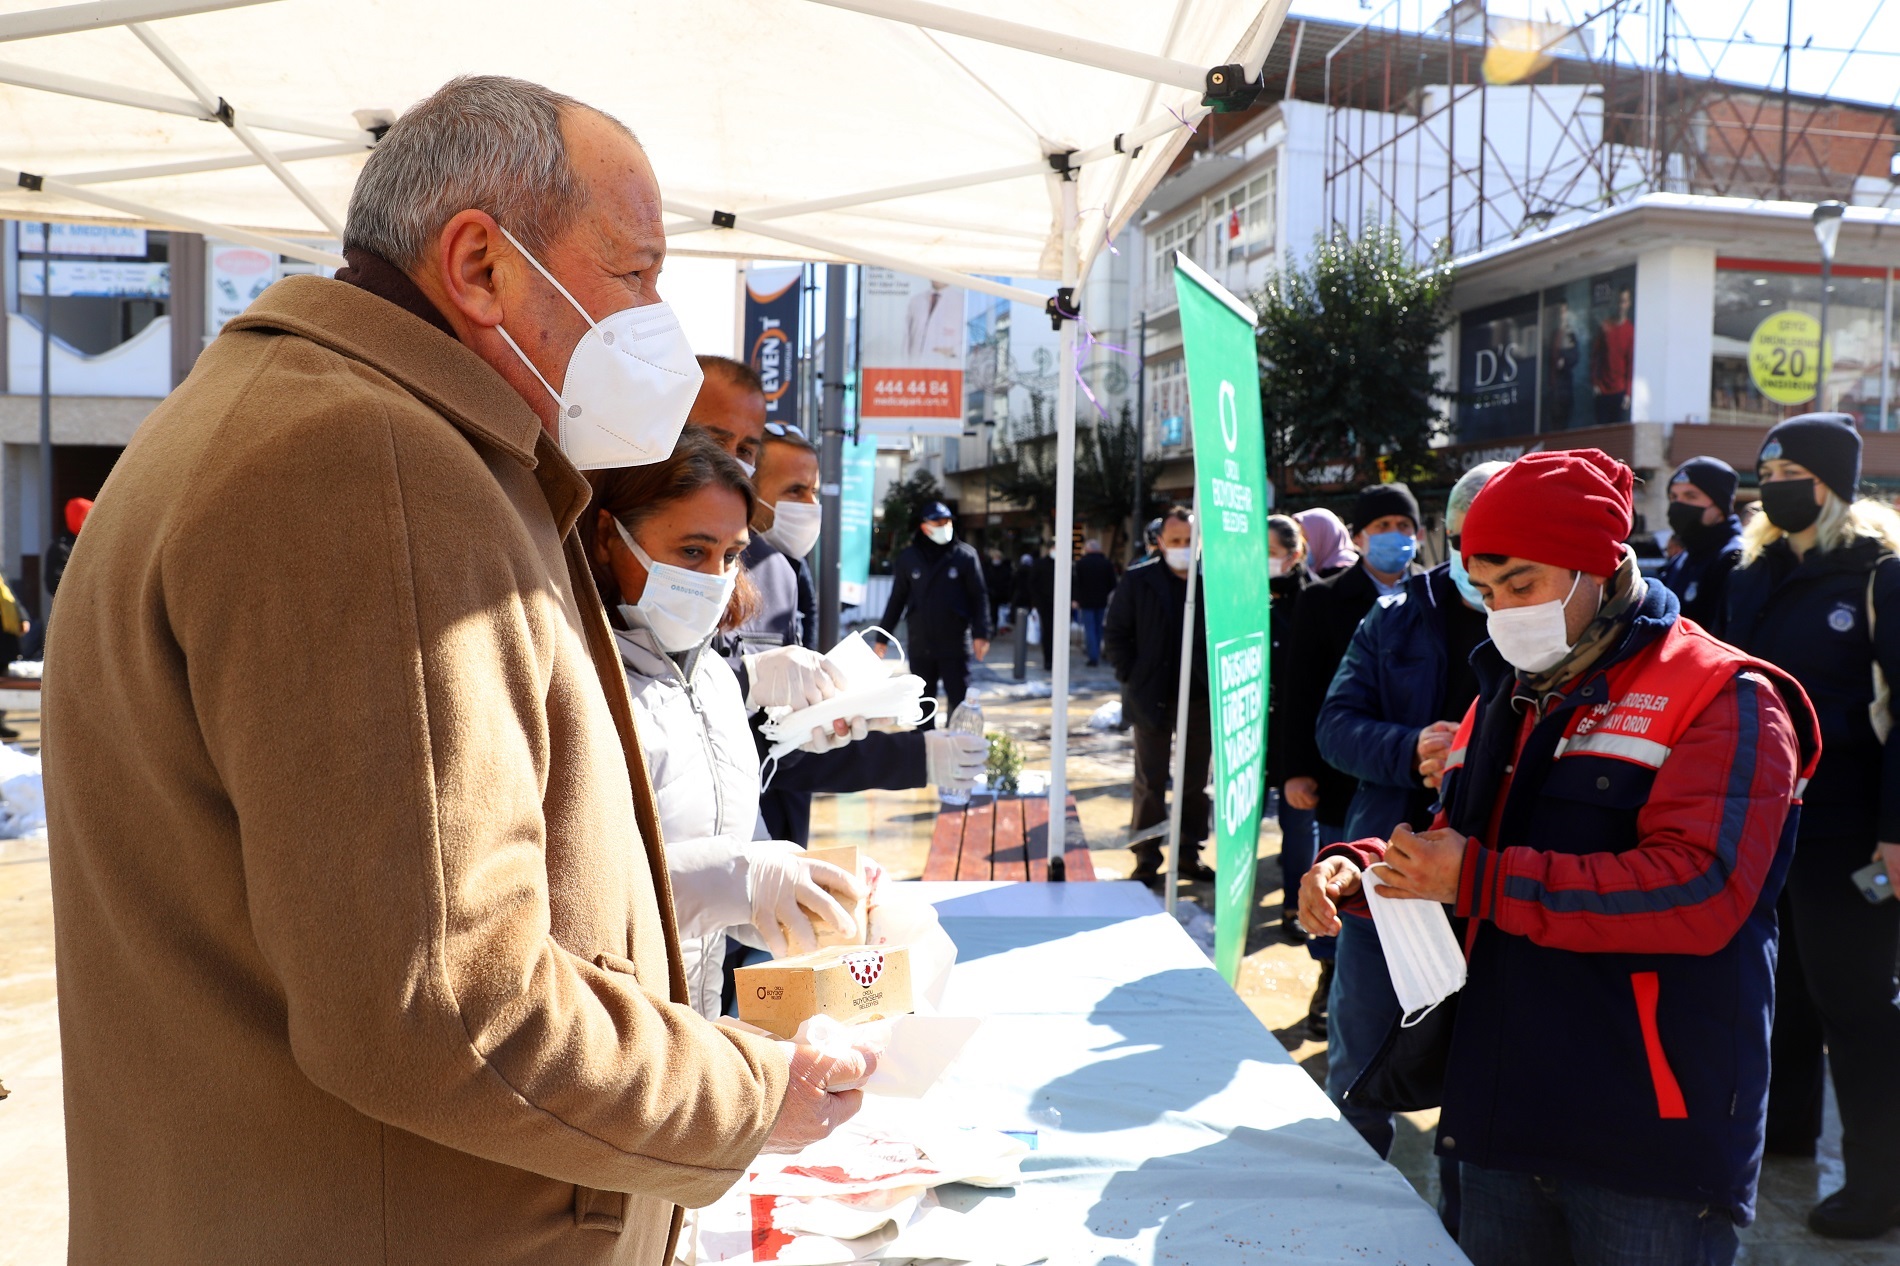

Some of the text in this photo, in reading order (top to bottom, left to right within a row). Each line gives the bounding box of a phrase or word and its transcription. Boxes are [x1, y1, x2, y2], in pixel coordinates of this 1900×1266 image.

[762, 317, 781, 412] LEVENT
[874, 380, 949, 396] 444 44 84
[1222, 680, 1262, 737] ÜRETEN
[1619, 692, 1669, 713] ARDEŞLER
[1622, 715, 1652, 734] ORDU
[1226, 756, 1260, 836] ORDU
